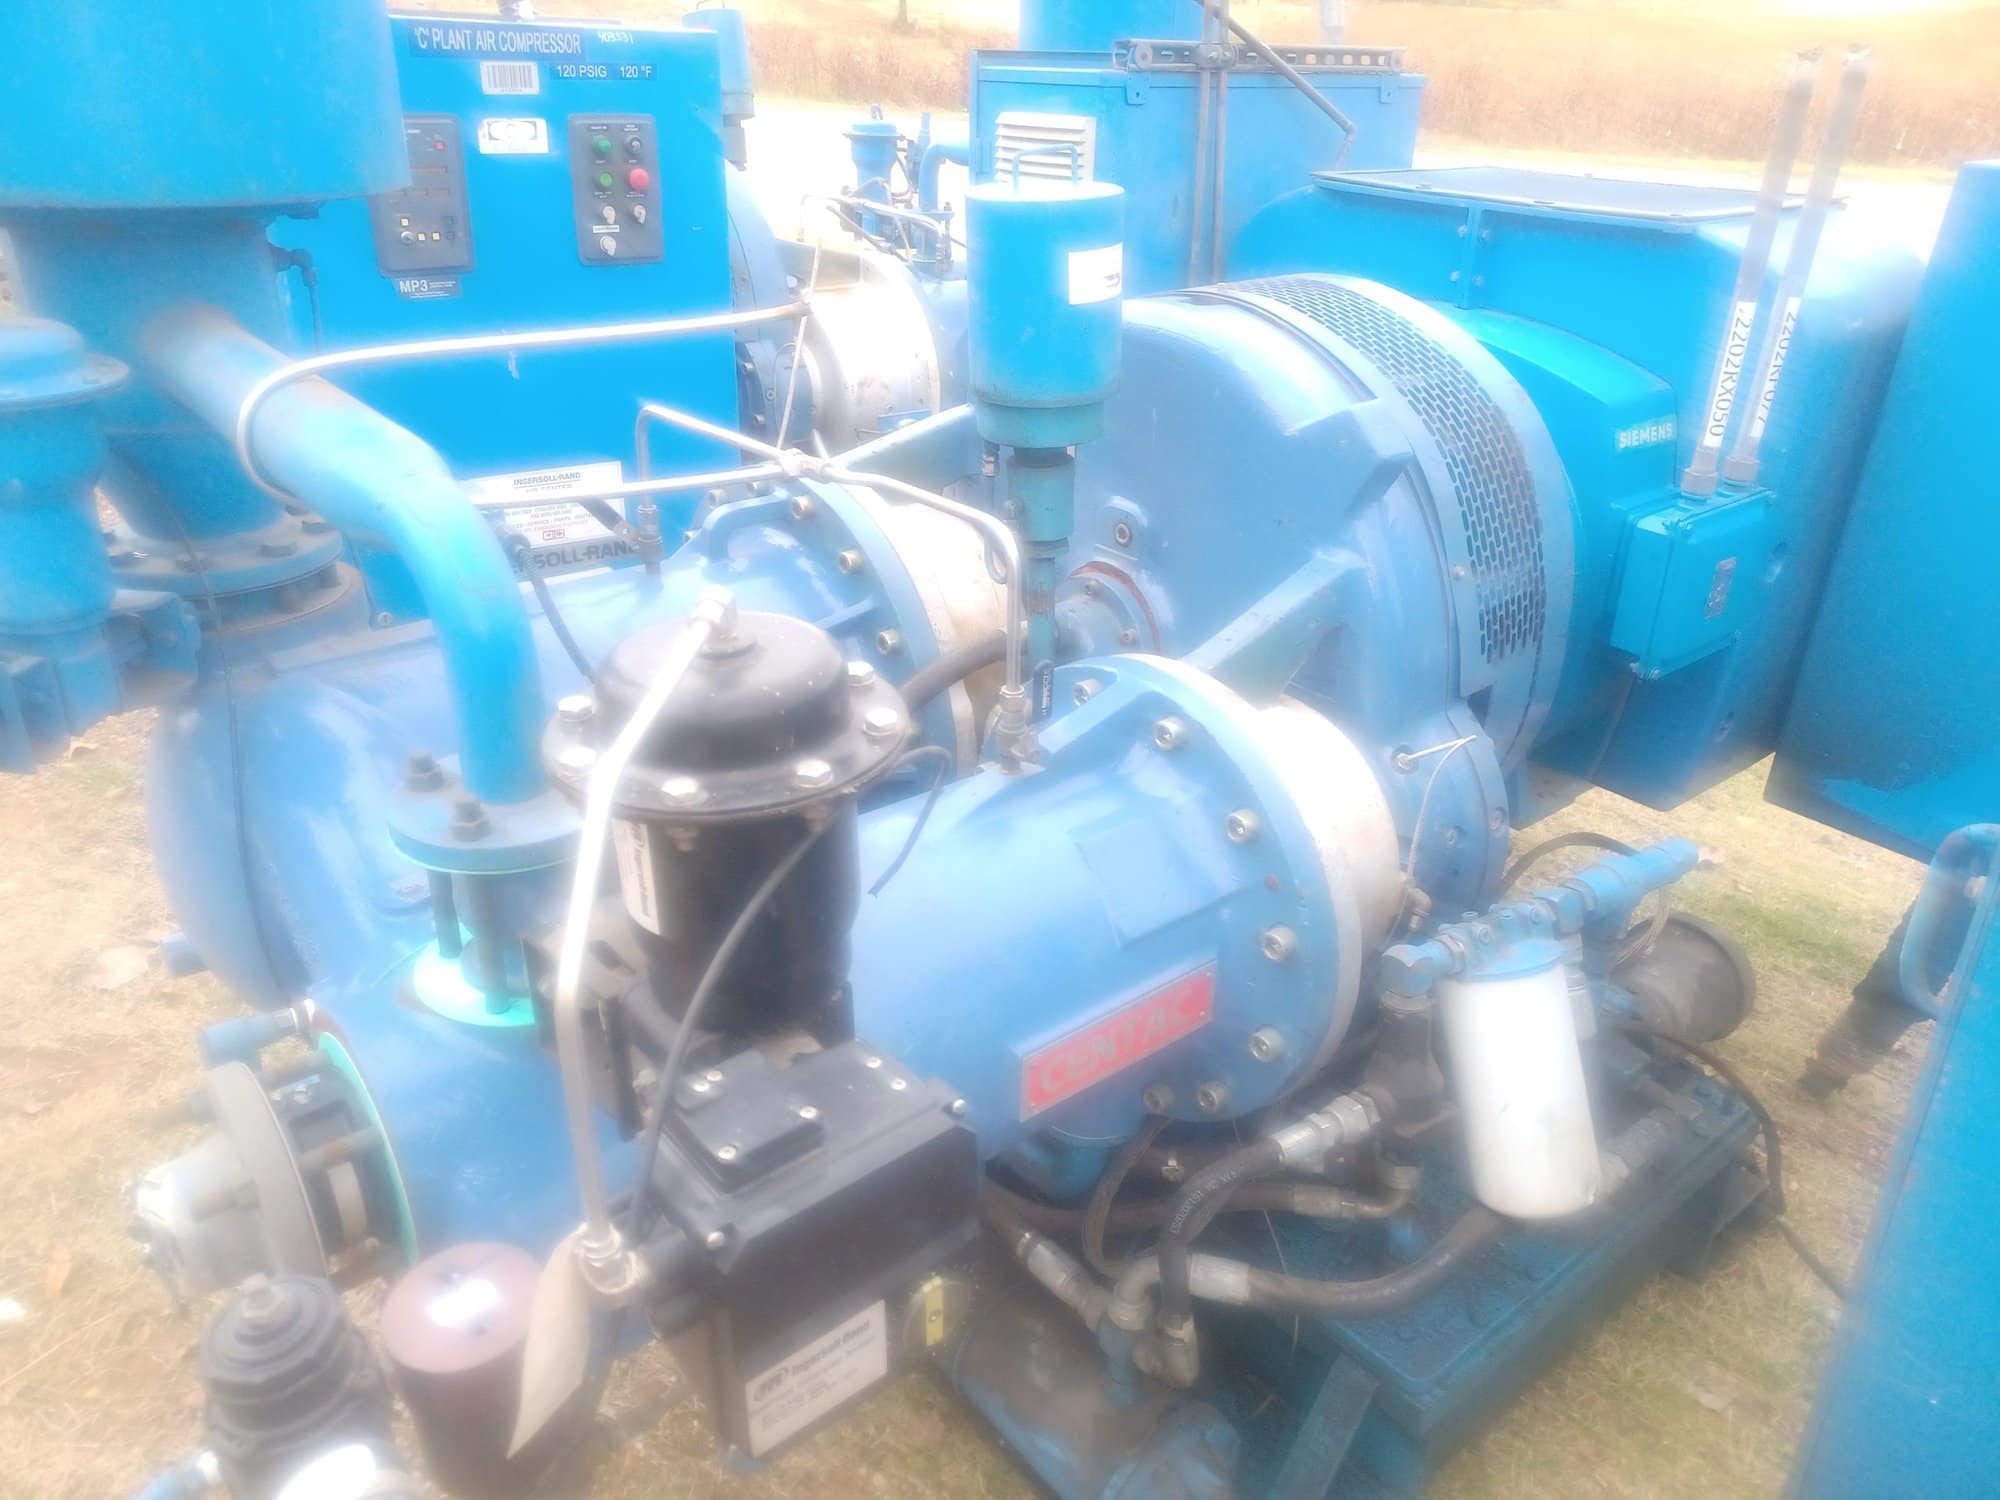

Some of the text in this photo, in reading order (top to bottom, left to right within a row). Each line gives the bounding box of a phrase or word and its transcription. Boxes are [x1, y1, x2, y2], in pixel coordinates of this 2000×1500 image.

[432, 28, 472, 50] PLANT
[476, 30, 497, 51] AIR
[499, 31, 582, 54] COMPRESSOR
[558, 64, 577, 78] 120
[579, 64, 608, 78] PSIG
[620, 65, 639, 78] 120
[399, 279, 429, 293] MP3
[1618, 423, 1674, 449] SIEMENS
[1040, 988, 1193, 1093] CENTAC
